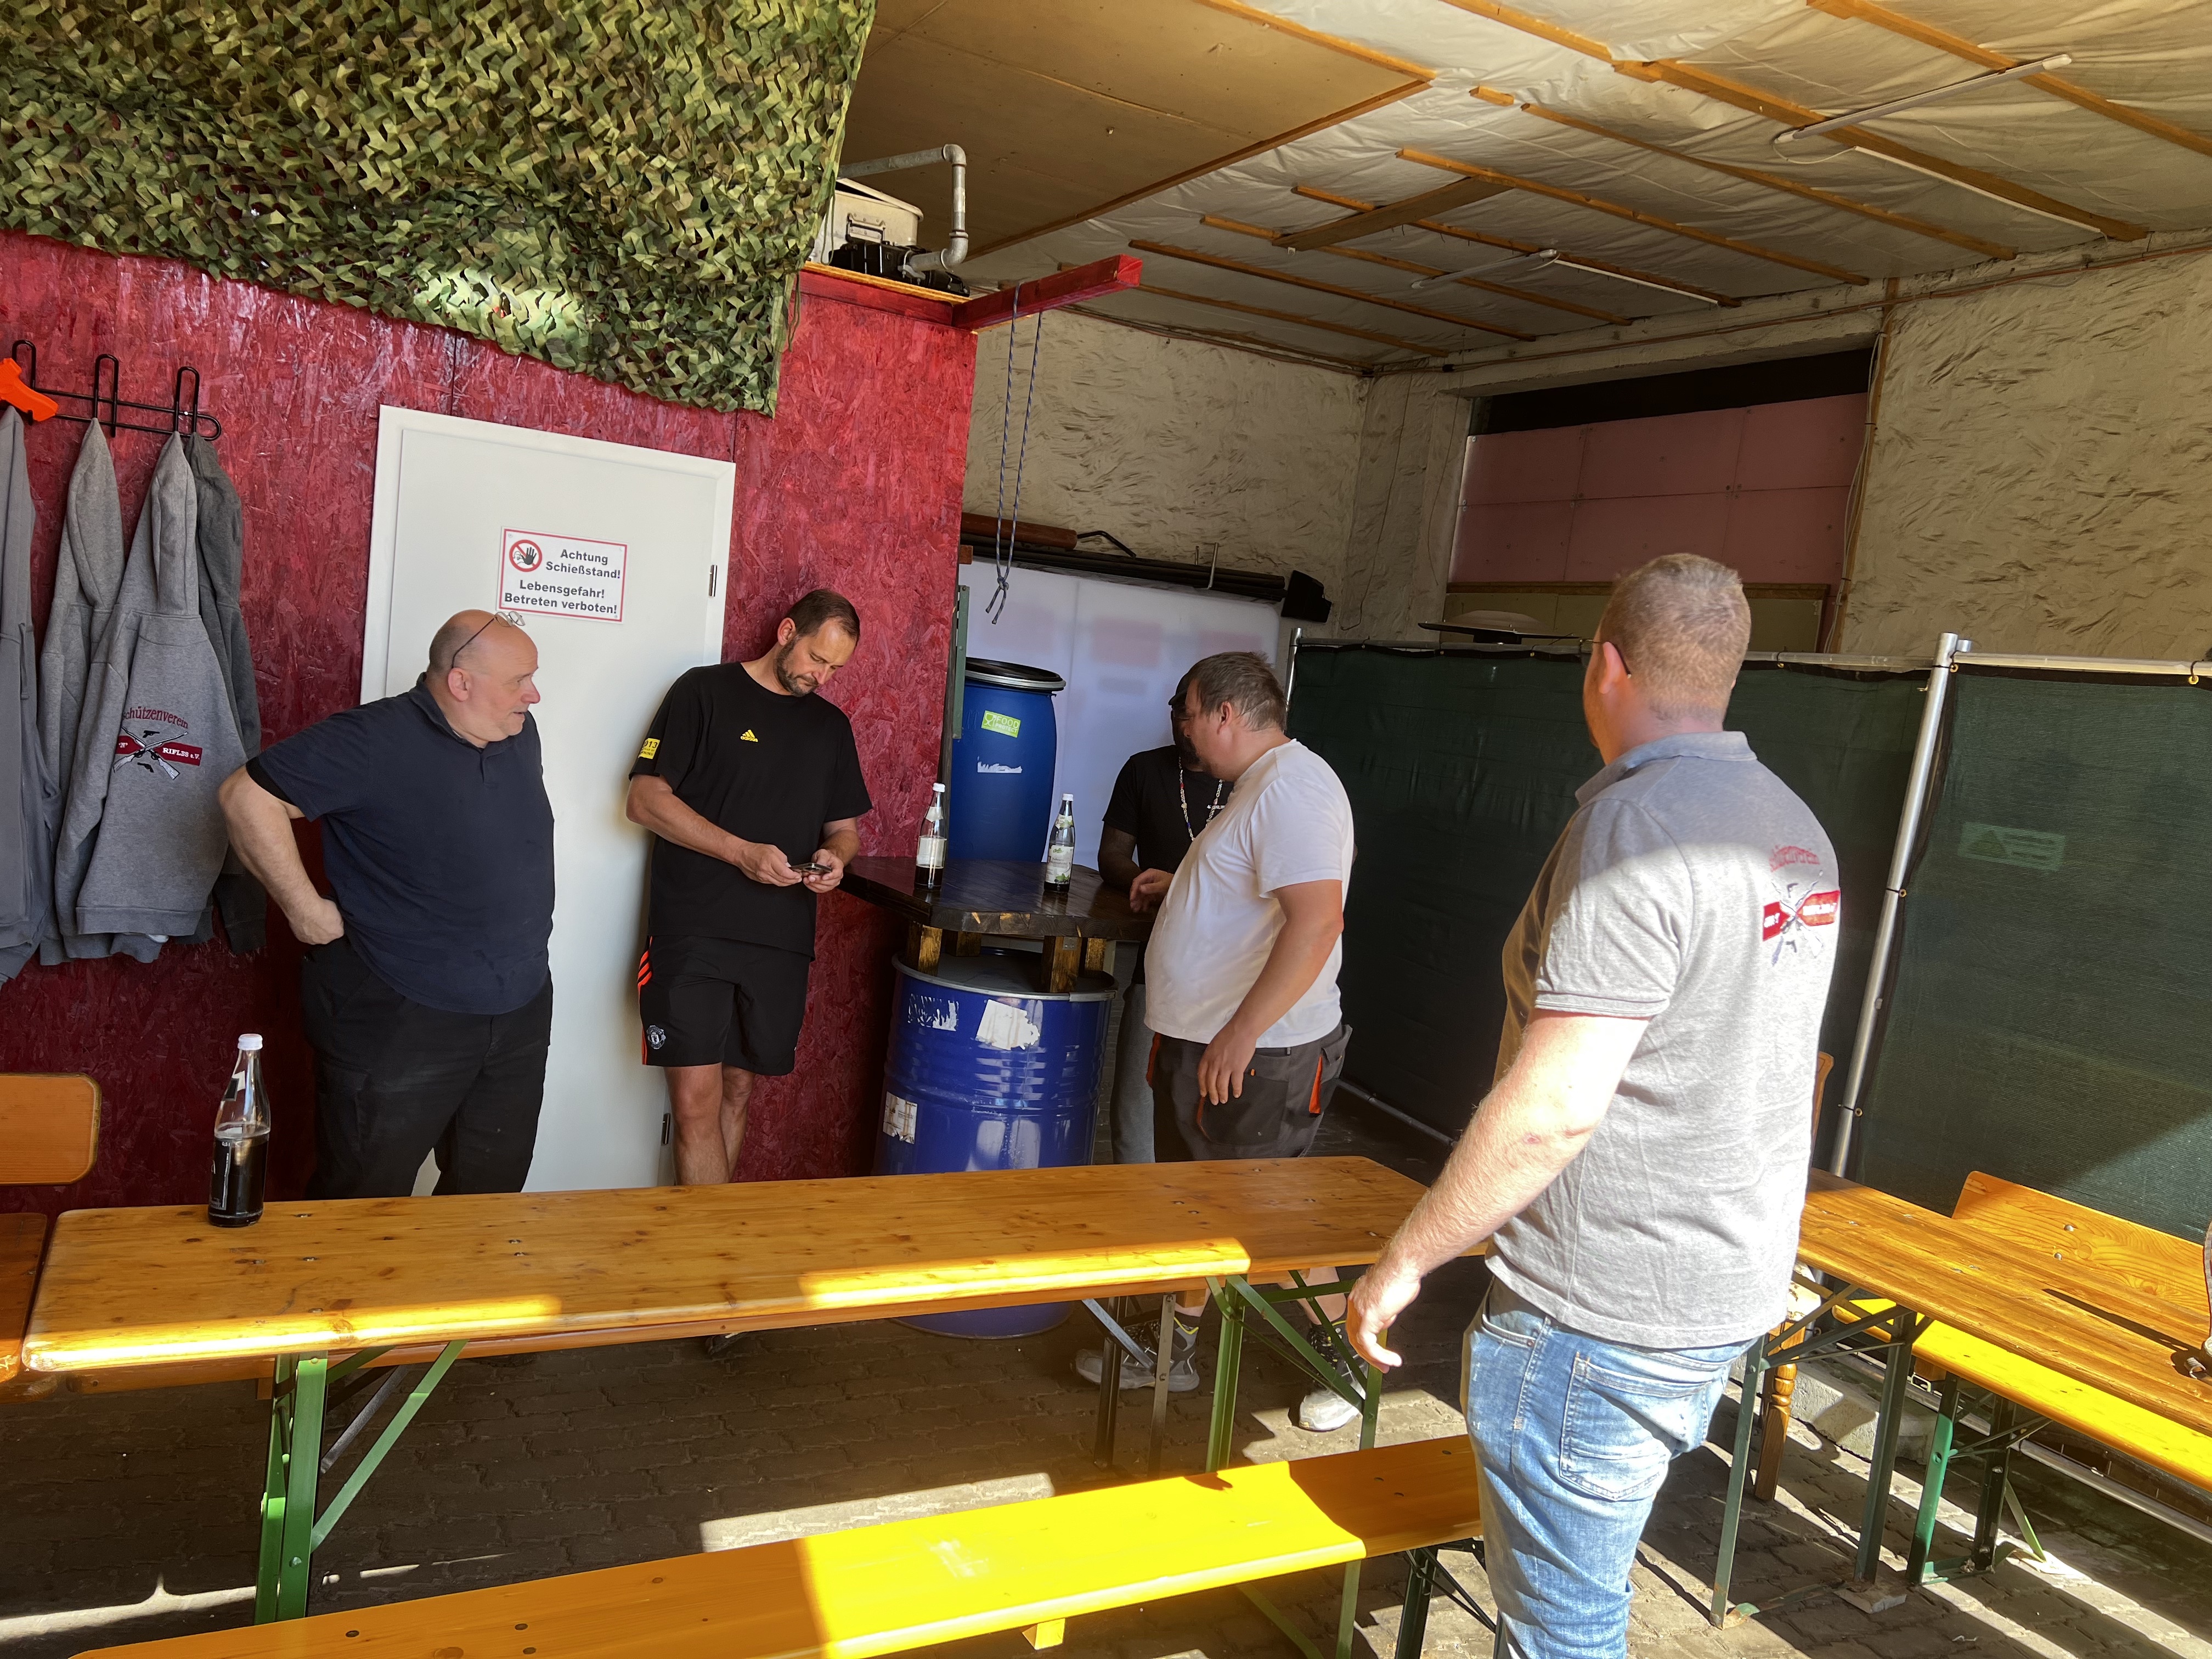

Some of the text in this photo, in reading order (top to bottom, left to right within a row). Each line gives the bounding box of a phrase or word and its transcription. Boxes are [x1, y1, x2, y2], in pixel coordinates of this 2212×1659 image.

[560, 549, 608, 565] Achtung
[545, 561, 620, 579] Schießstand!
[520, 579, 605, 598] Lebensgefahr!
[504, 592, 617, 614] Betreten verboten!
[995, 723, 1018, 733] PROTECT
[996, 715, 1019, 729] FOOD
[162, 747, 189, 757] RIFLES
